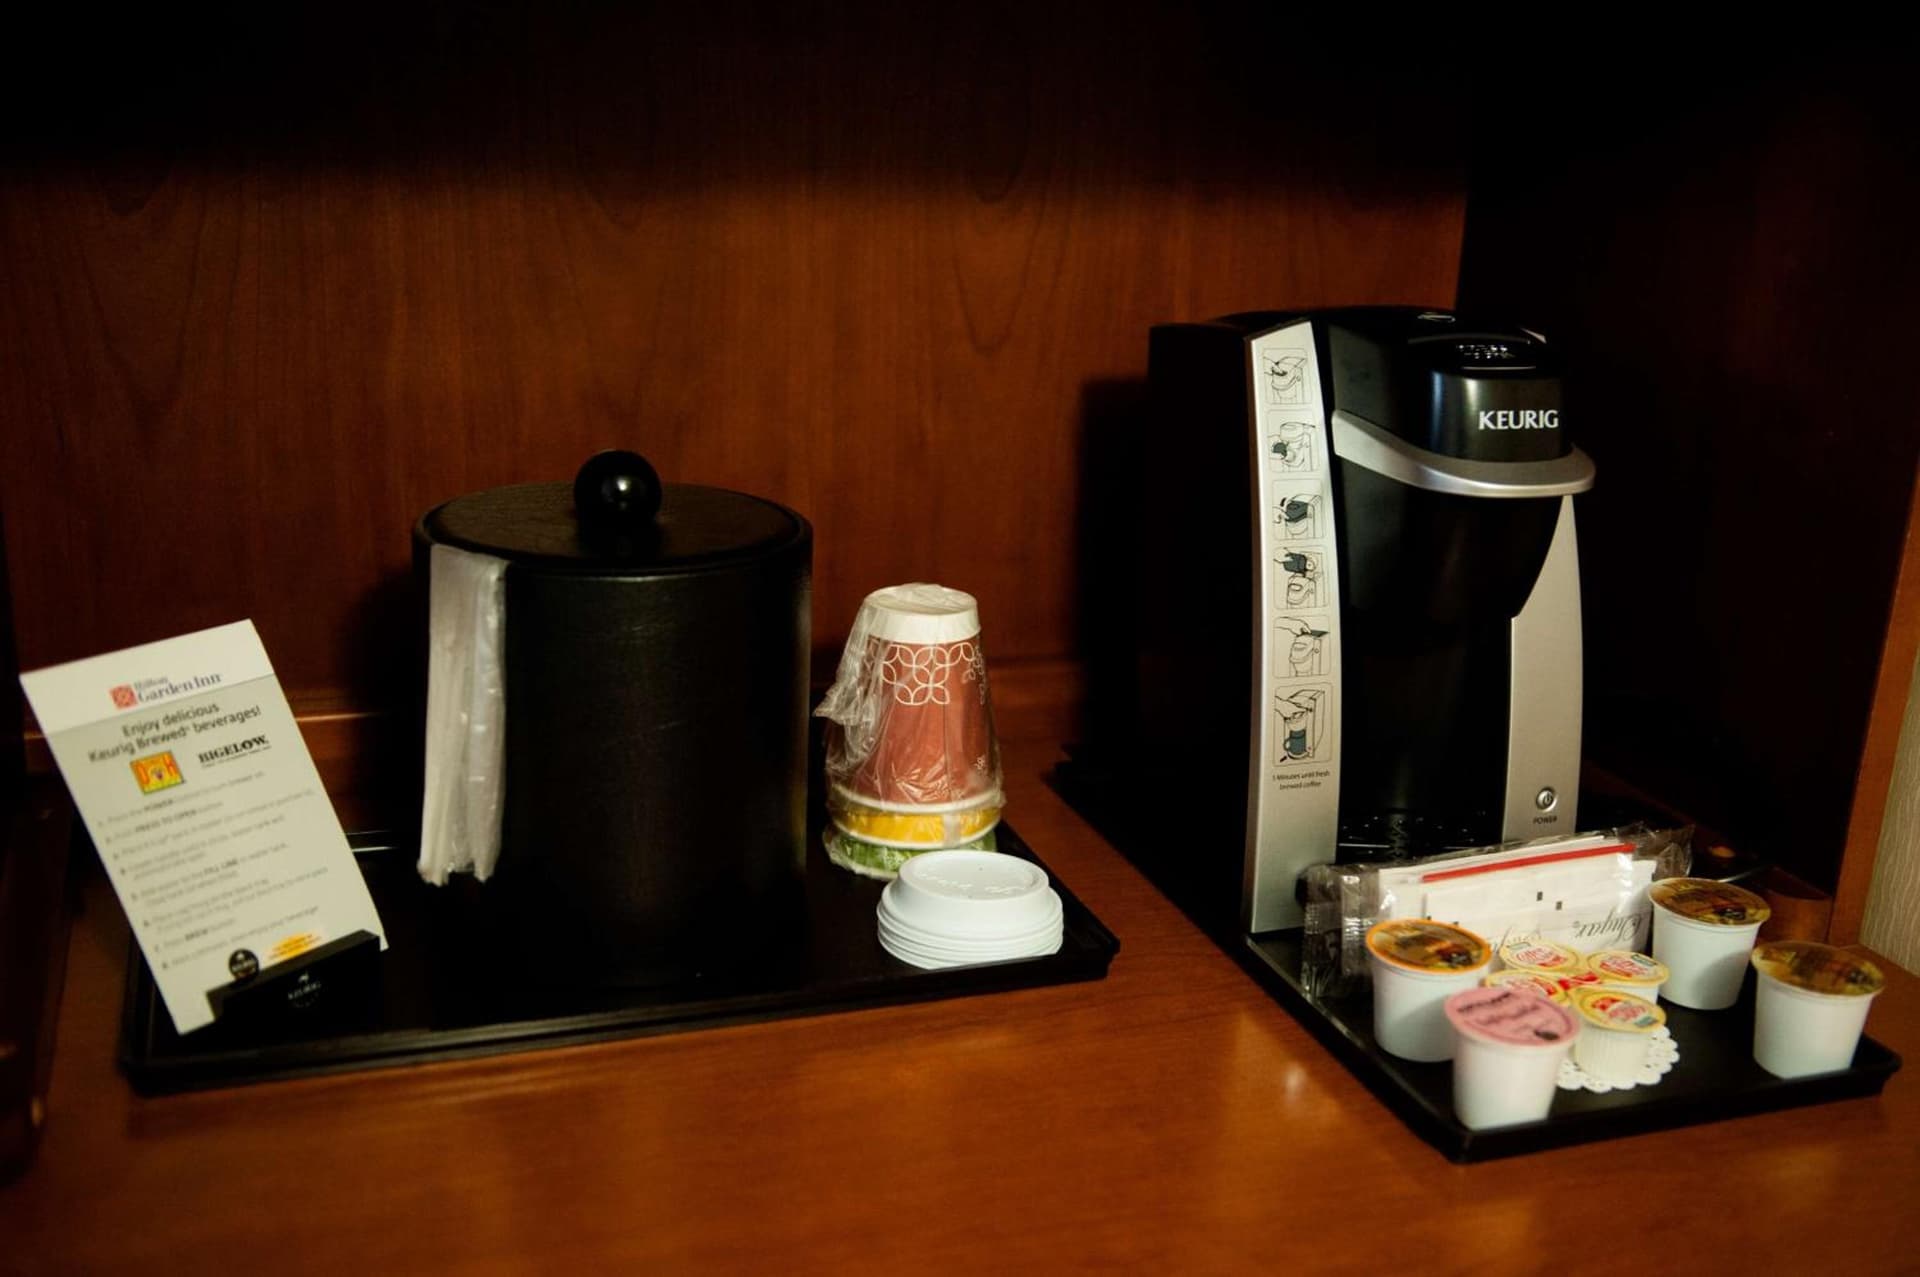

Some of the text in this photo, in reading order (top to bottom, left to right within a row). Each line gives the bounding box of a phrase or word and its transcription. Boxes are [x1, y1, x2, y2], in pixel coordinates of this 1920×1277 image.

[1478, 409, 1560, 431] KEURIG
[88, 740, 136, 761] Keurig
[193, 705, 262, 733] beverages!
[122, 703, 221, 739] Enjoy delicious
[198, 734, 268, 763] BIGELOW
[1575, 909, 1643, 943] Sugar
